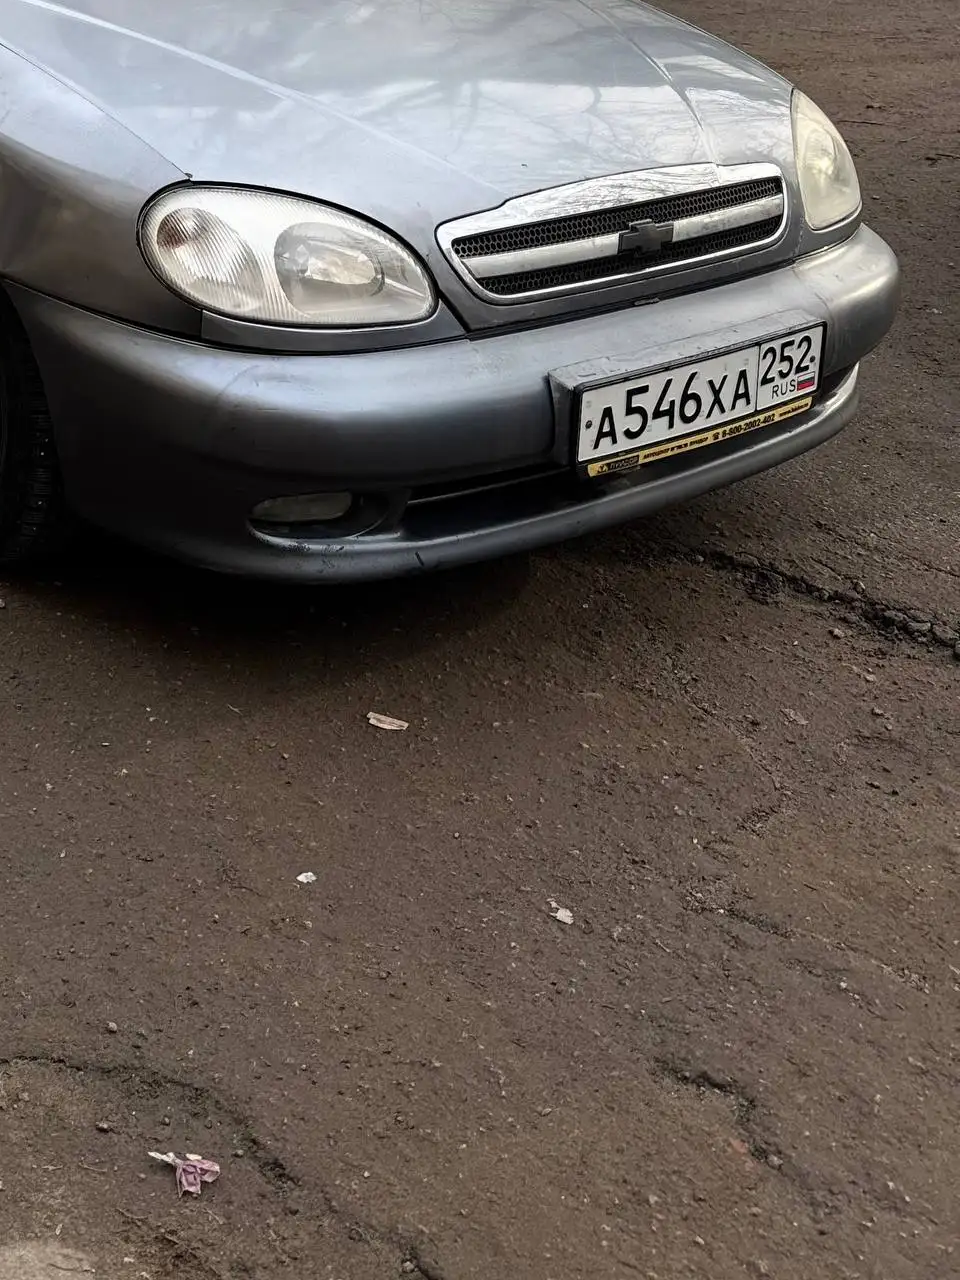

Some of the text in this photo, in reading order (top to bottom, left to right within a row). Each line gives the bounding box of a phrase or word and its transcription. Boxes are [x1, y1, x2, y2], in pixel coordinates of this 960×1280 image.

[593, 335, 812, 449] А546ХА 252
[771, 380, 796, 400] RUS
